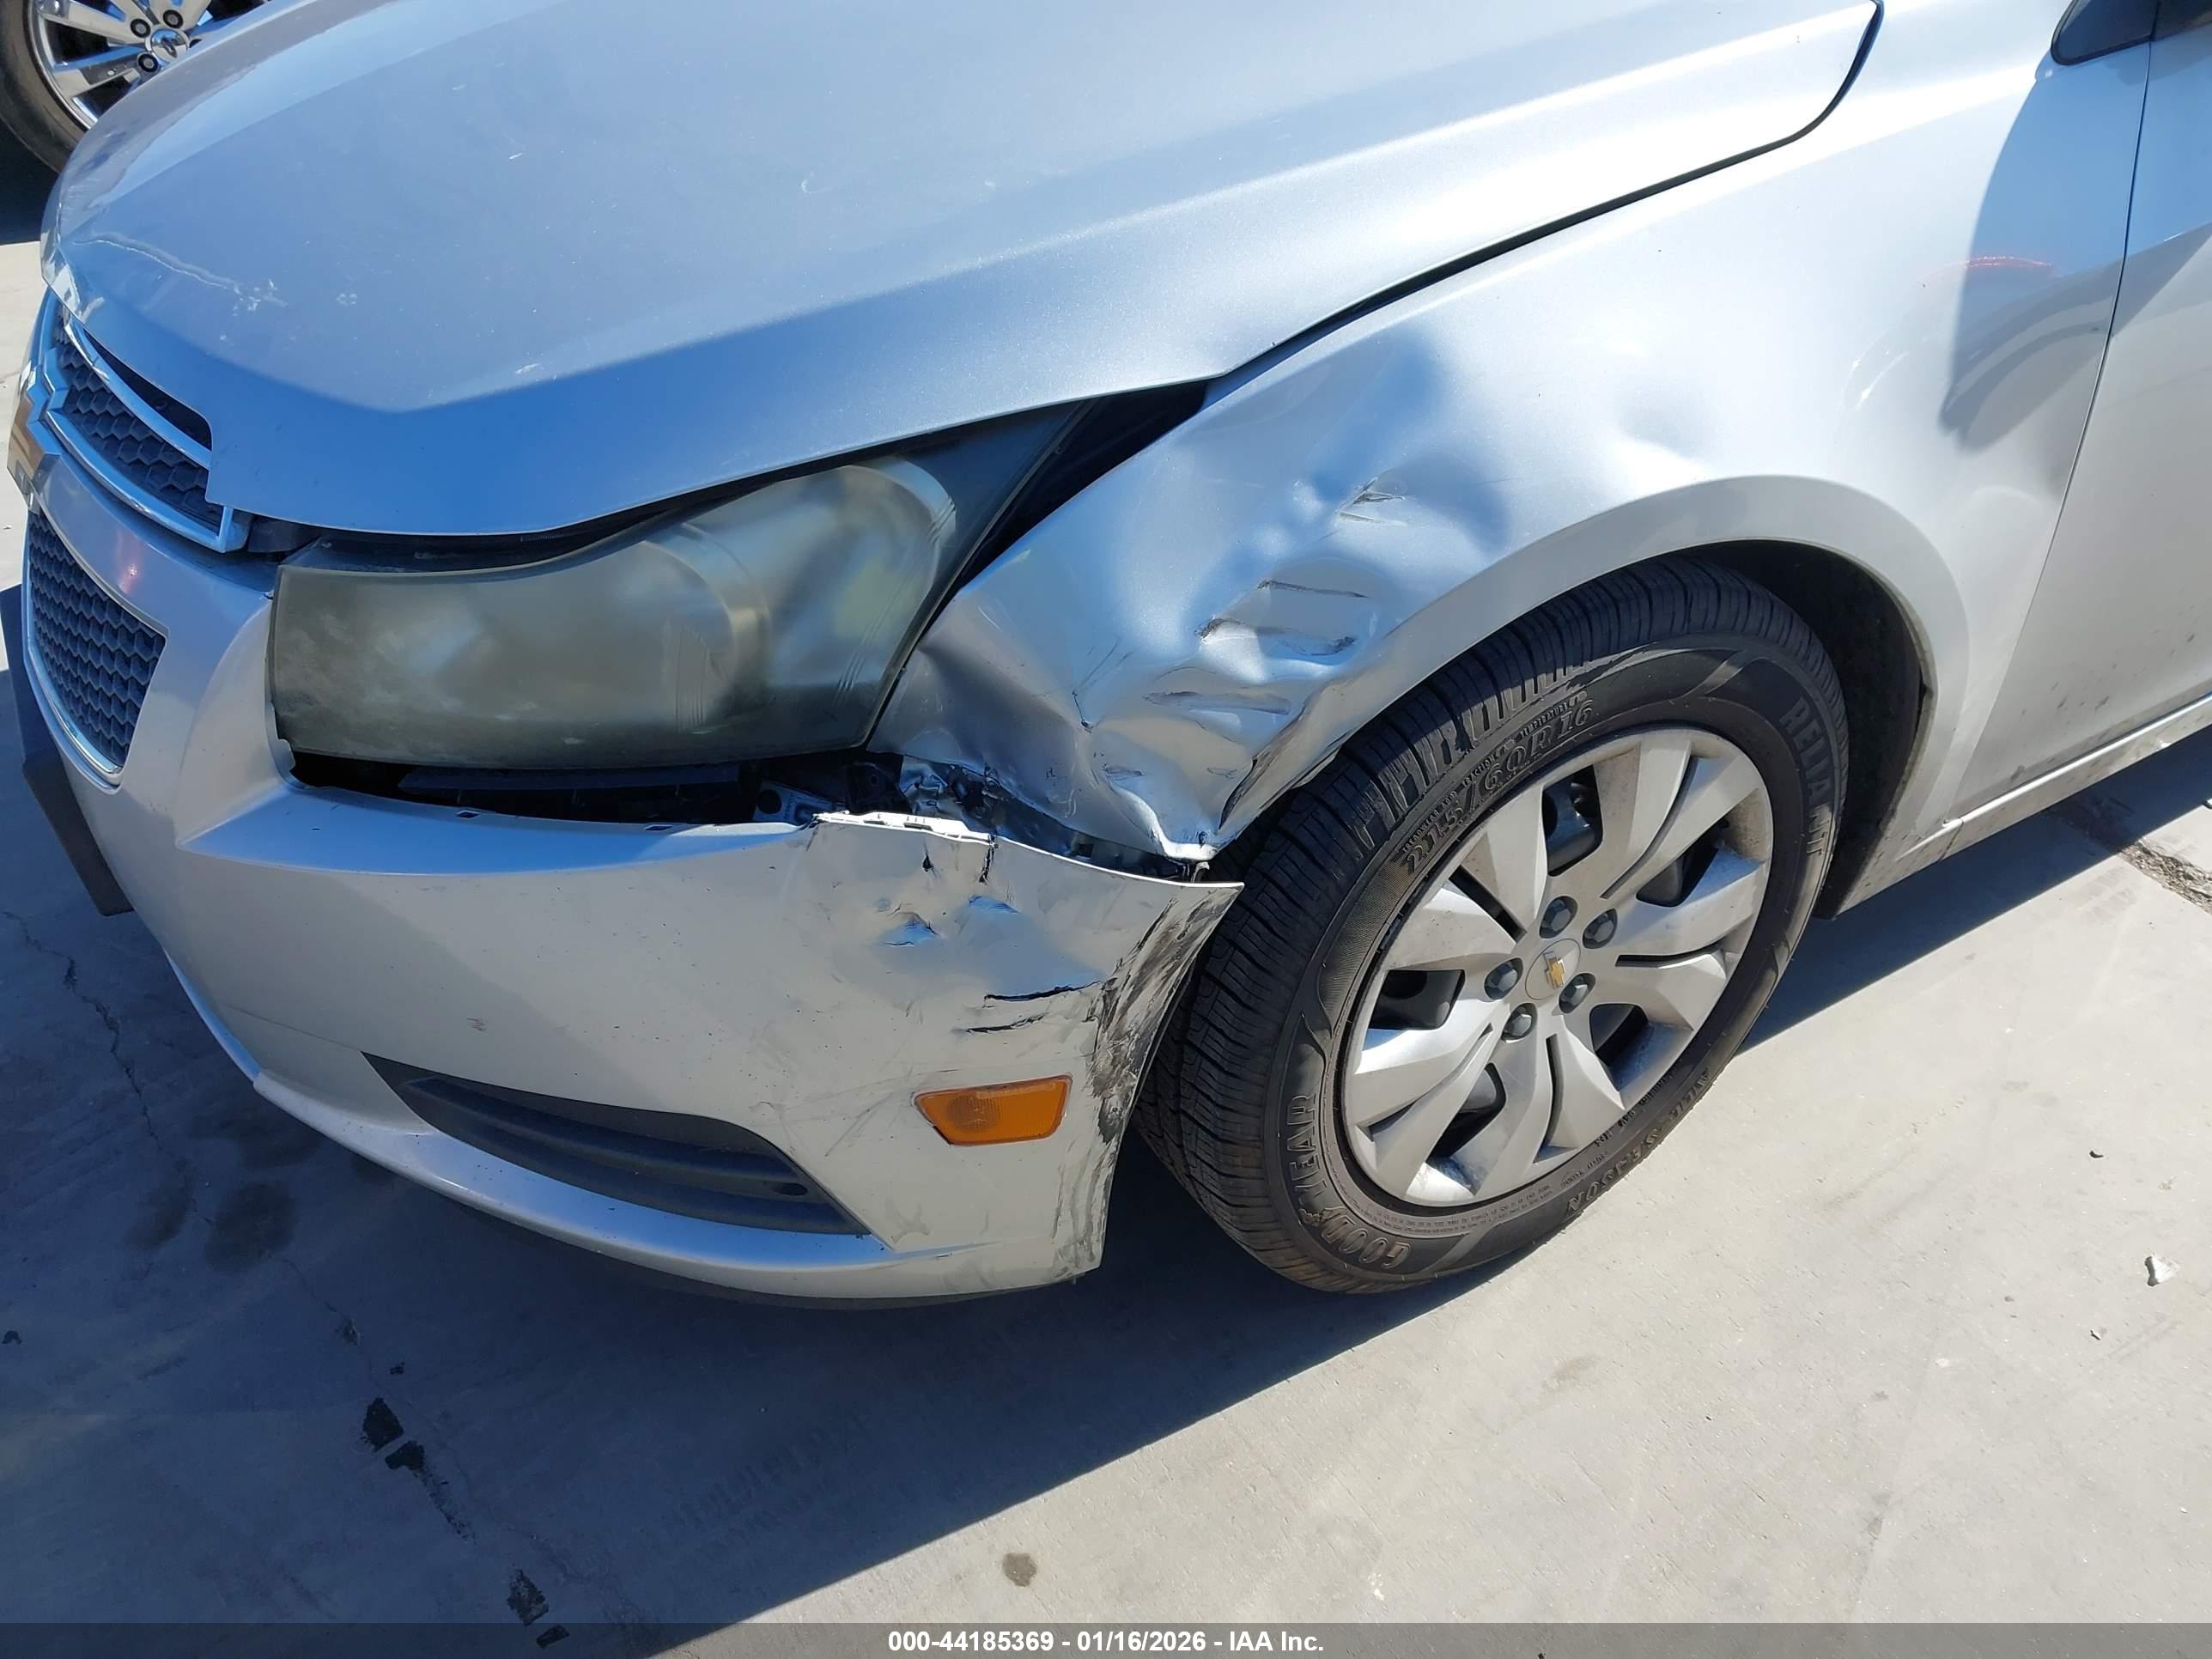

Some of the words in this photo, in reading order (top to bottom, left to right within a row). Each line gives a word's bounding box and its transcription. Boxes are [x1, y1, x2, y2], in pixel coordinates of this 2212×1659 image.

[1401, 809, 1438, 852] TREADWEAR
[1461, 752, 1495, 788] TRACTION
[1778, 694, 1833, 854] RELIANT
[1566, 1125, 1662, 1215] SEASON
